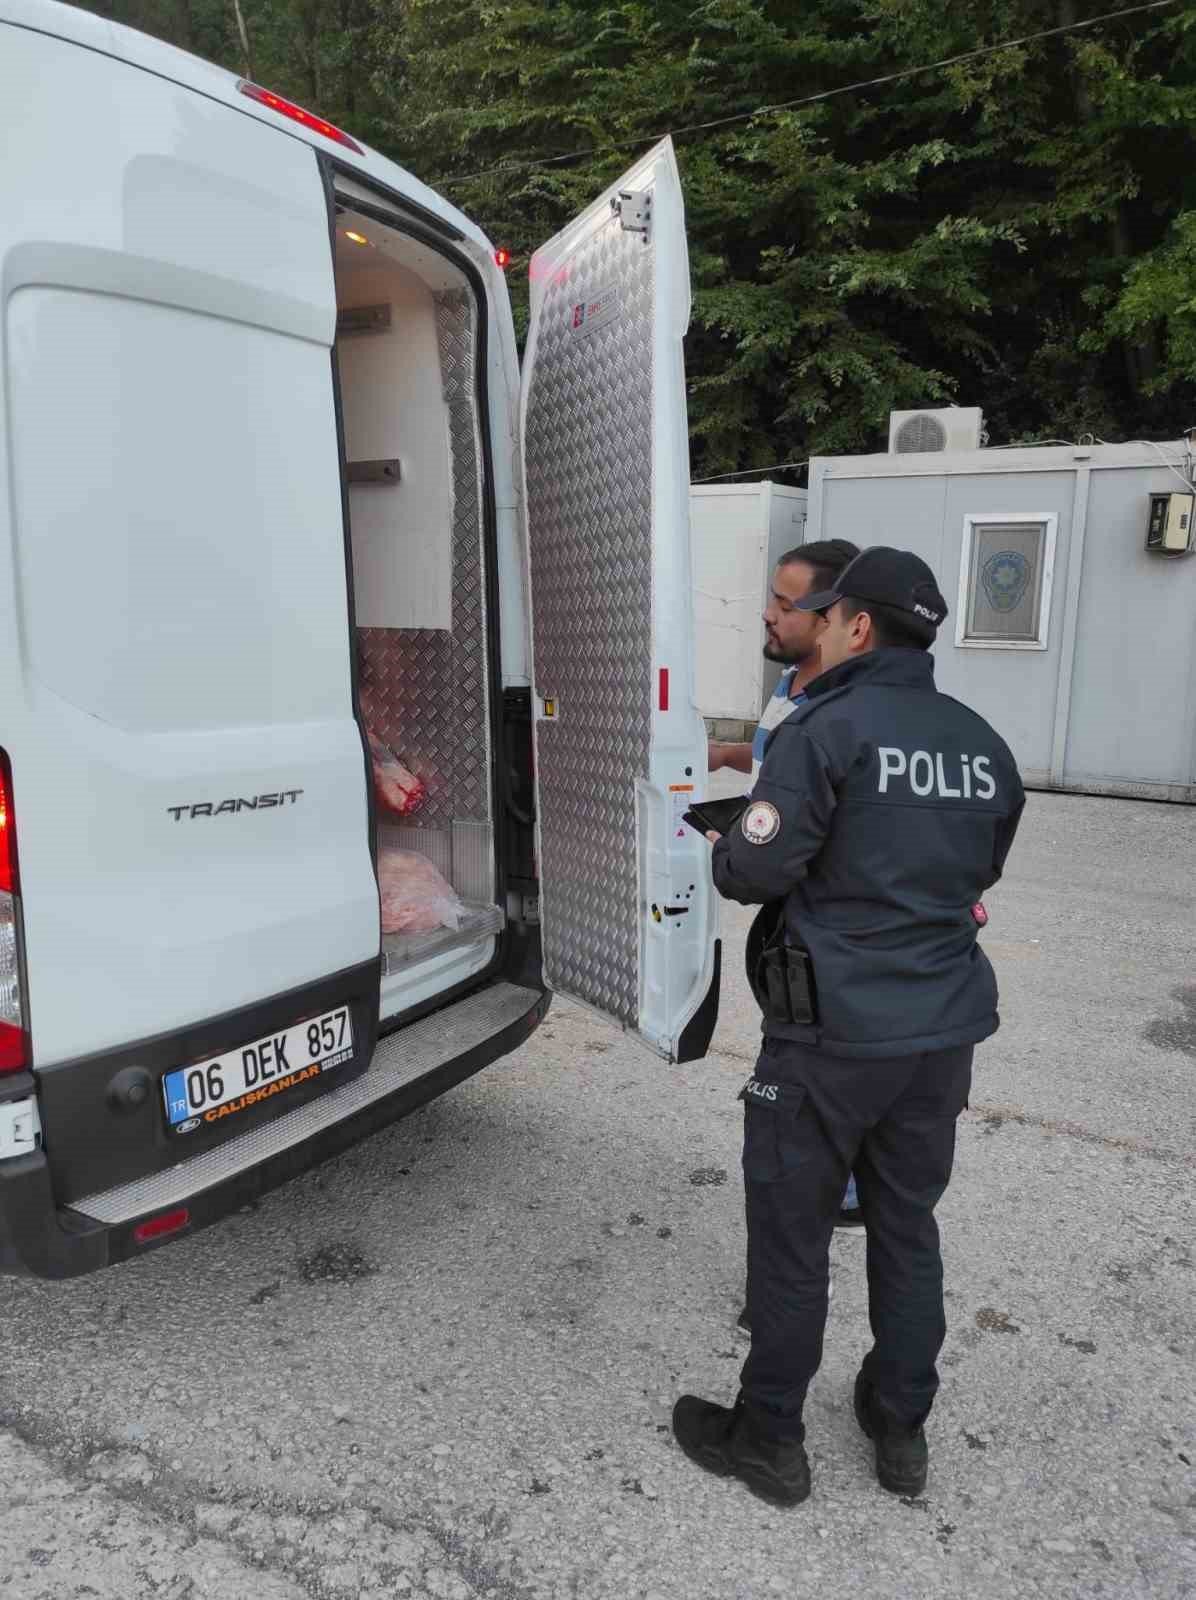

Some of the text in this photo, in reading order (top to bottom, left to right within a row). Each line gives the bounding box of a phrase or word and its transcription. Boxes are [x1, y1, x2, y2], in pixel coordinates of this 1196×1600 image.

[167, 789, 304, 821] TRANSIT
[187, 1062, 225, 1109] 06
[242, 1034, 290, 1088] DEK
[307, 1010, 347, 1058] 857
[745, 1080, 779, 1100] OLIS
[171, 1099, 186, 1113] TR
